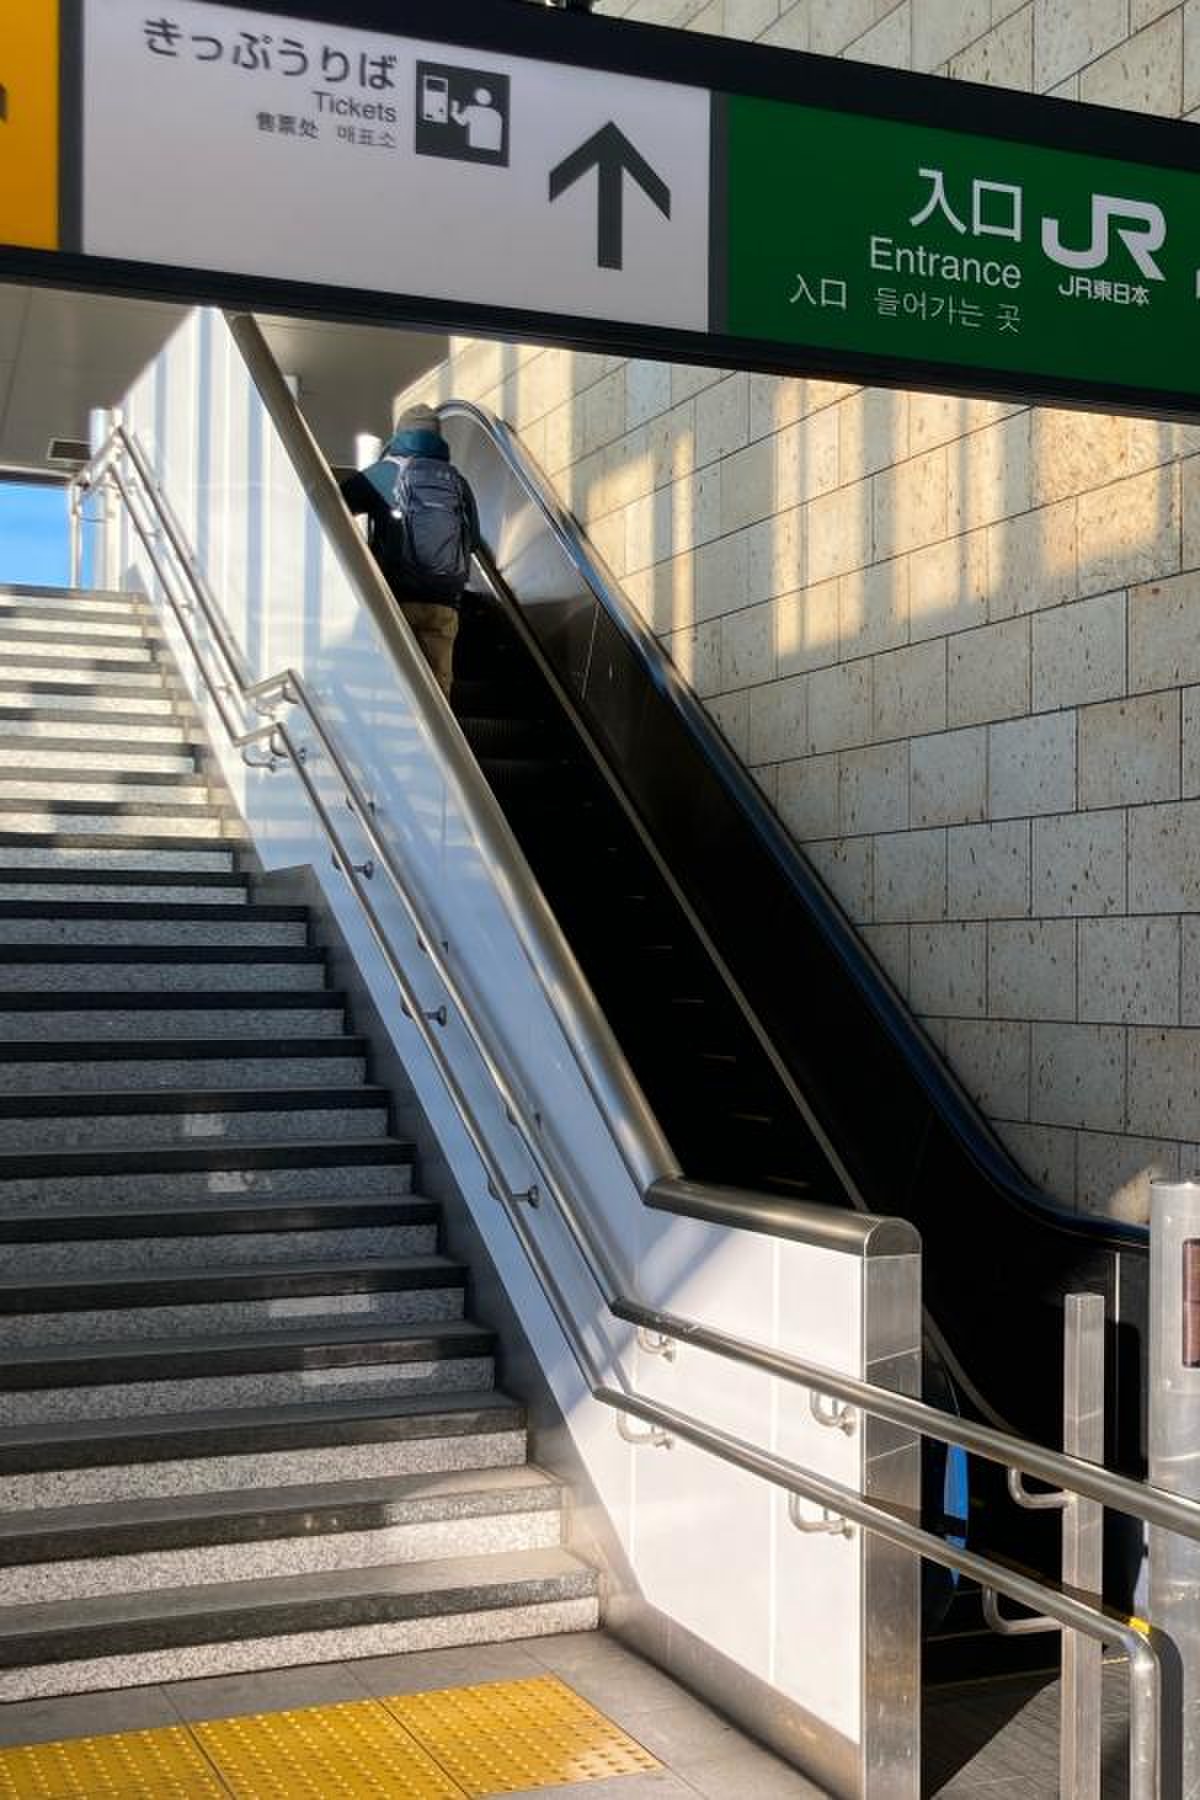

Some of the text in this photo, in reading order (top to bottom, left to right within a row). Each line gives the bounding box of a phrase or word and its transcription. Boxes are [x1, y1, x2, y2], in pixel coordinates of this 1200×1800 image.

[143, 18, 397, 90] きっぷうりば
[312, 90, 398, 123] Tickets
[337, 125, 397, 149] 매표소
[909, 167, 1023, 242] 入口
[1041, 193, 1168, 282] JR
[869, 235, 1023, 290] Entrance
[789, 273, 847, 309] 入口
[874, 286, 1022, 334] 들어가는 곳
[1058, 274, 1151, 307] JR東日本
